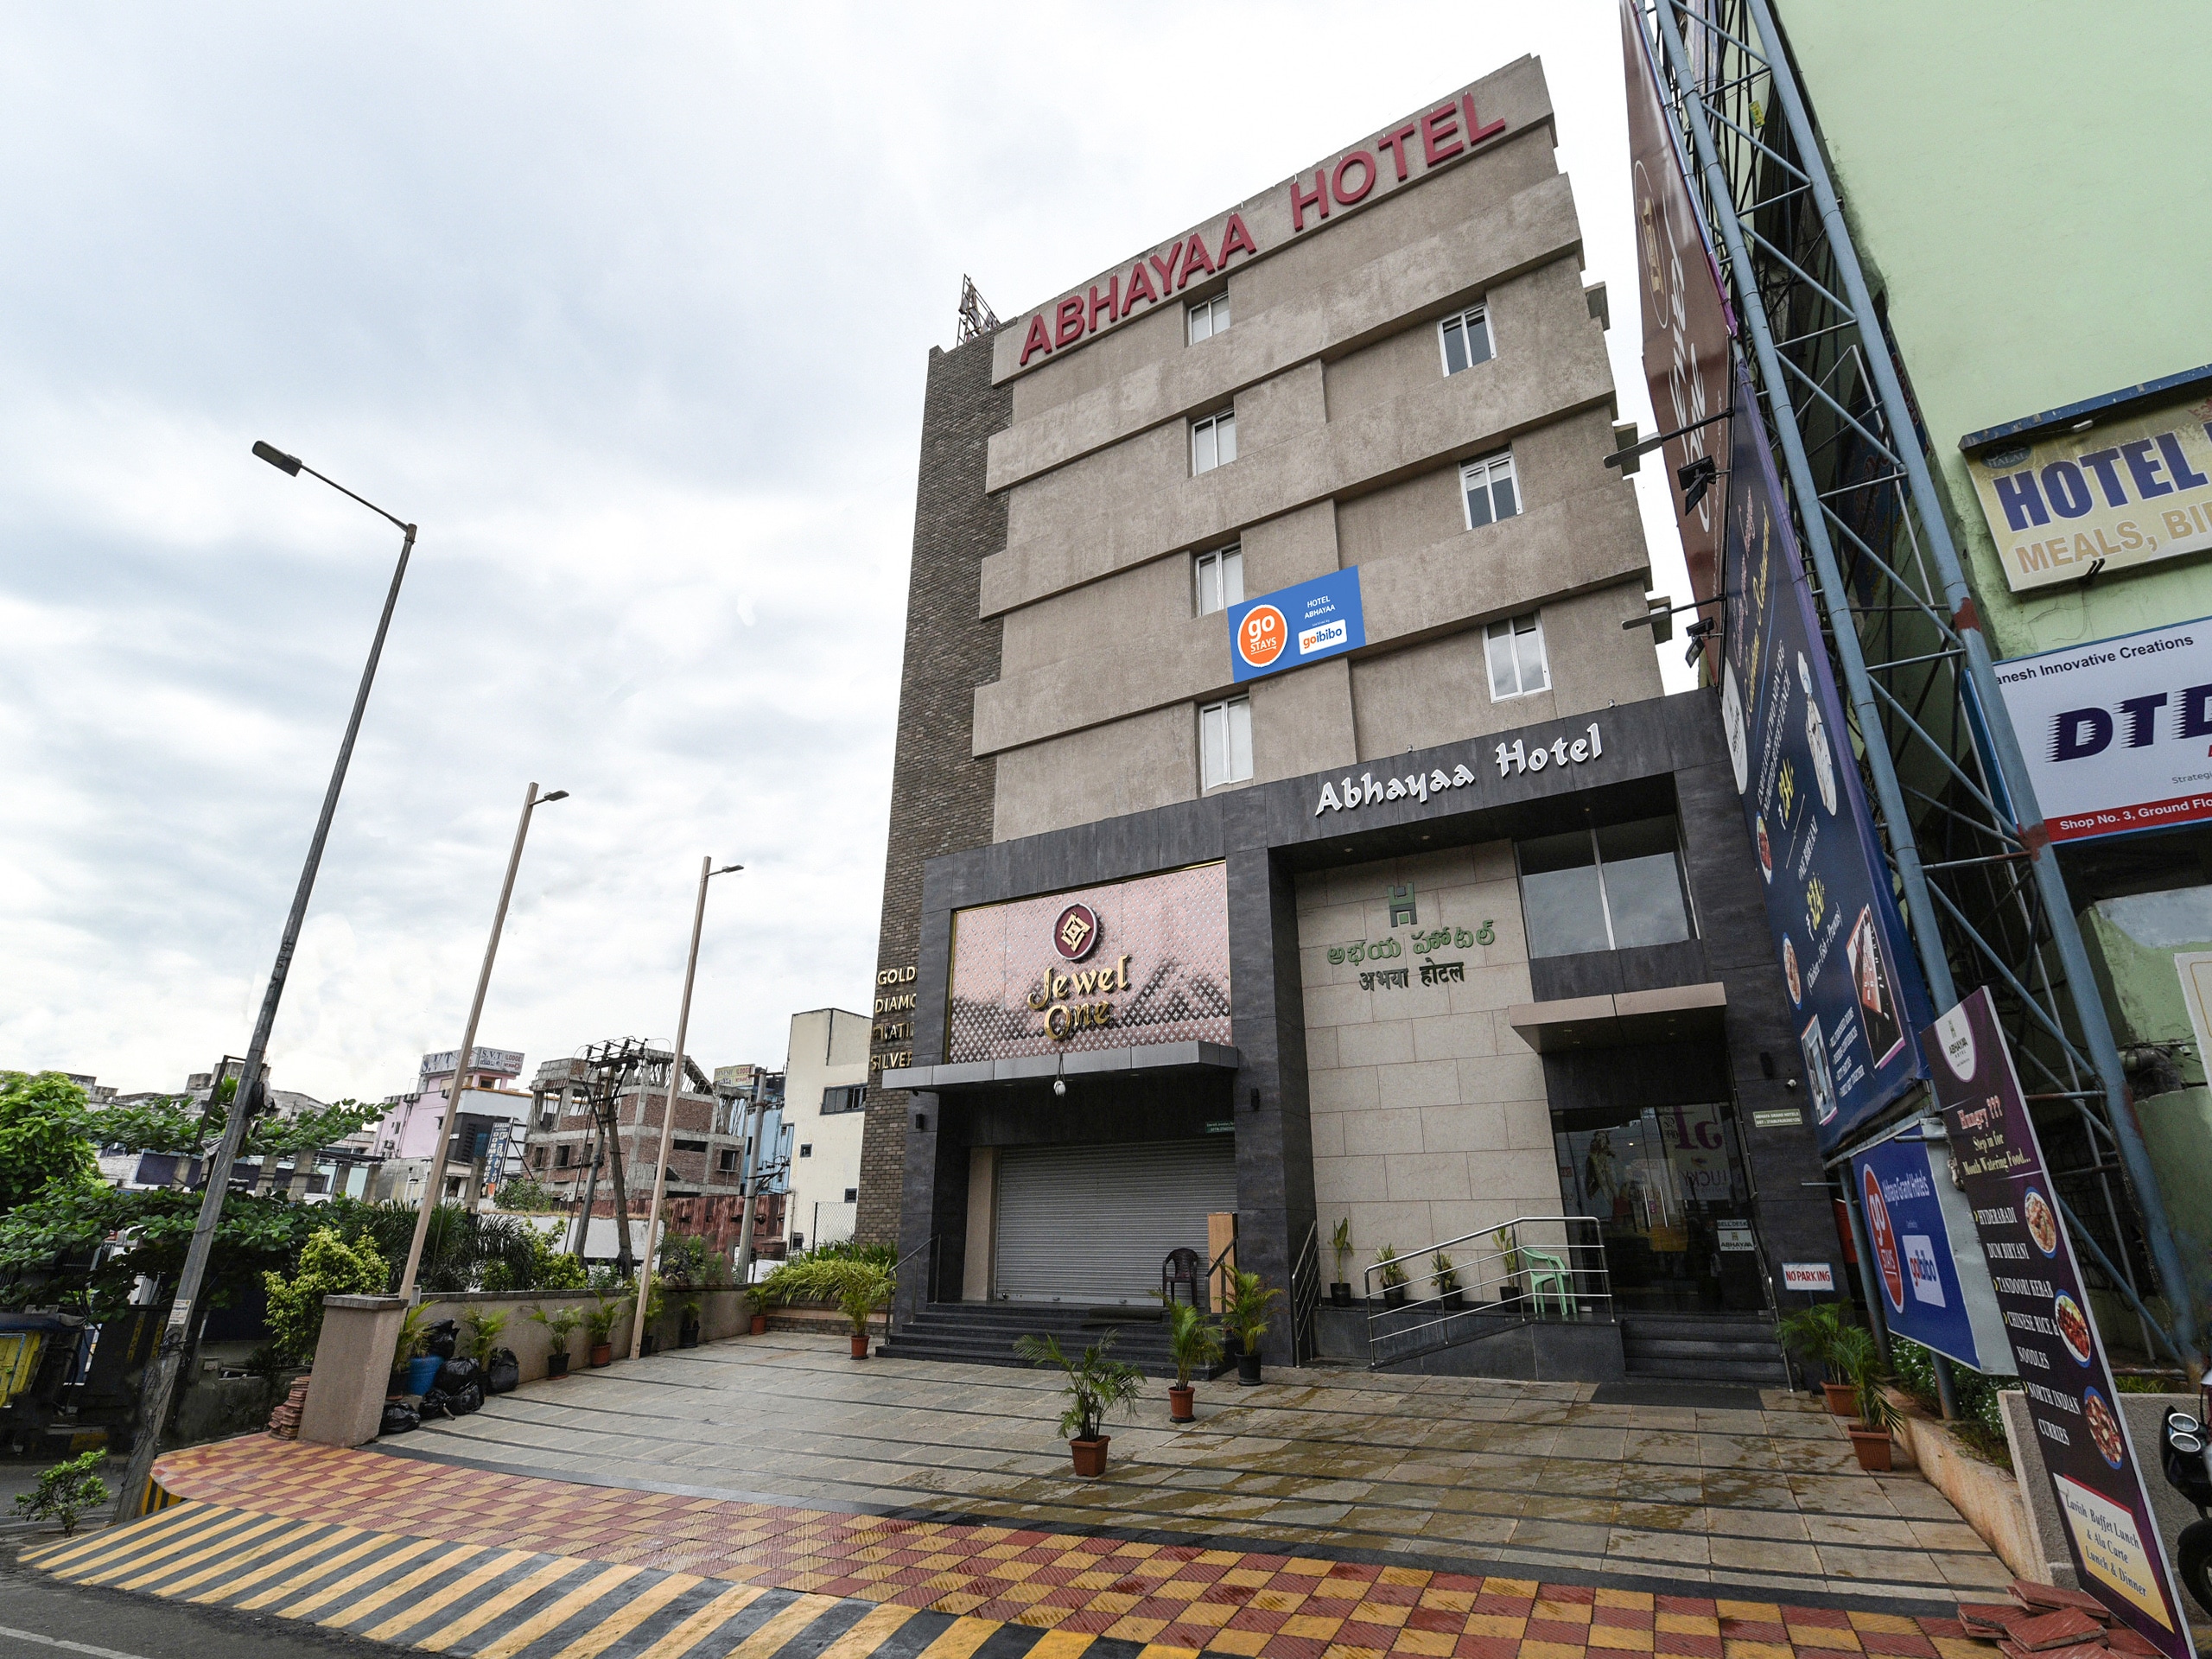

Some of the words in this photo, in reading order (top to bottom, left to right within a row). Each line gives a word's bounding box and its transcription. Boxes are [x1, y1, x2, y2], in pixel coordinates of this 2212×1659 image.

[1020, 213, 1256, 367] ABHAYAA
[1290, 91, 1505, 232] HOTEL
[1993, 432, 2209, 533] HOTEL
[2014, 520, 2158, 575] MEALS,
[1304, 604, 1336, 620] ABHAYAA
[1306, 595, 1331, 608] HOTEL
[1248, 615, 1275, 644] go
[1303, 627, 1343, 649] goibibo
[1250, 637, 1277, 652] STAYS
[2040, 652, 2116, 677] Innovative
[2120, 635, 2194, 659] Creations
[1315, 764, 1475, 817] Abhayaa
[1495, 723, 1603, 777] Hotel
[2060, 814, 2094, 830] Shop
[2097, 810, 2120, 825] No.
[2123, 810, 2136, 821] 3,
[2139, 802, 2190, 817] Ground
[1327, 937, 1402, 966] అభయ
[877, 966, 917, 985] GOLD
[1027, 953, 1133, 1010] Jewel
[1359, 968, 1409, 991] अभया
[1420, 957, 1465, 987] होटल
[1044, 999, 1110, 1040] One
[1957, 1106, 1989, 1130] Hungry
[1973, 1135, 1988, 1153] Step
[1986, 1133, 1995, 1148] in
[1993, 1130, 2005, 1146] for
[1962, 1159, 1982, 1176] Mouth
[1980, 1154, 2009, 1173] Watering
[1910, 1169, 1929, 1198] Hotels
[1868, 1193, 1886, 1246] go
[1977, 1207, 2018, 1225] HYDERABADI
[1880, 1249, 1896, 1270] STAYS
[1986, 1243, 2002, 1259] DUM
[2000, 1243, 2030, 1260] BIRYANI
[1785, 1271, 1796, 1281] NO
[1797, 1270, 1830, 1281] PARKING
[1910, 1249, 1937, 1287] goibibo
[1996, 1277, 2031, 1294] TANDOORI
[2030, 1281, 2055, 1298] KEBAB
[2006, 1312, 2036, 1332] CHINESE
[2035, 1316, 2054, 1336] RICE
[2052, 1324, 2060, 1337] &
[2016, 1346, 2050, 1370] NOODLES
[2028, 1382, 2055, 1406] NORTH
[2052, 1390, 2082, 1415] INDIAN
[2037, 1418, 2070, 1446] CURRIES
[2065, 1495, 2088, 1518] Lavish
[2089, 1509, 2113, 1533] Buffet
[2114, 1522, 2140, 1550] Lunch
[2086, 1529, 2092, 1541] &
[2094, 1533, 2107, 1548] Ala
[2107, 1540, 2129, 1564] Carte
[2085, 1545, 2109, 1572] Lunch
[2110, 1564, 2118, 1578] &
[2118, 1567, 2147, 1597] Dinner
